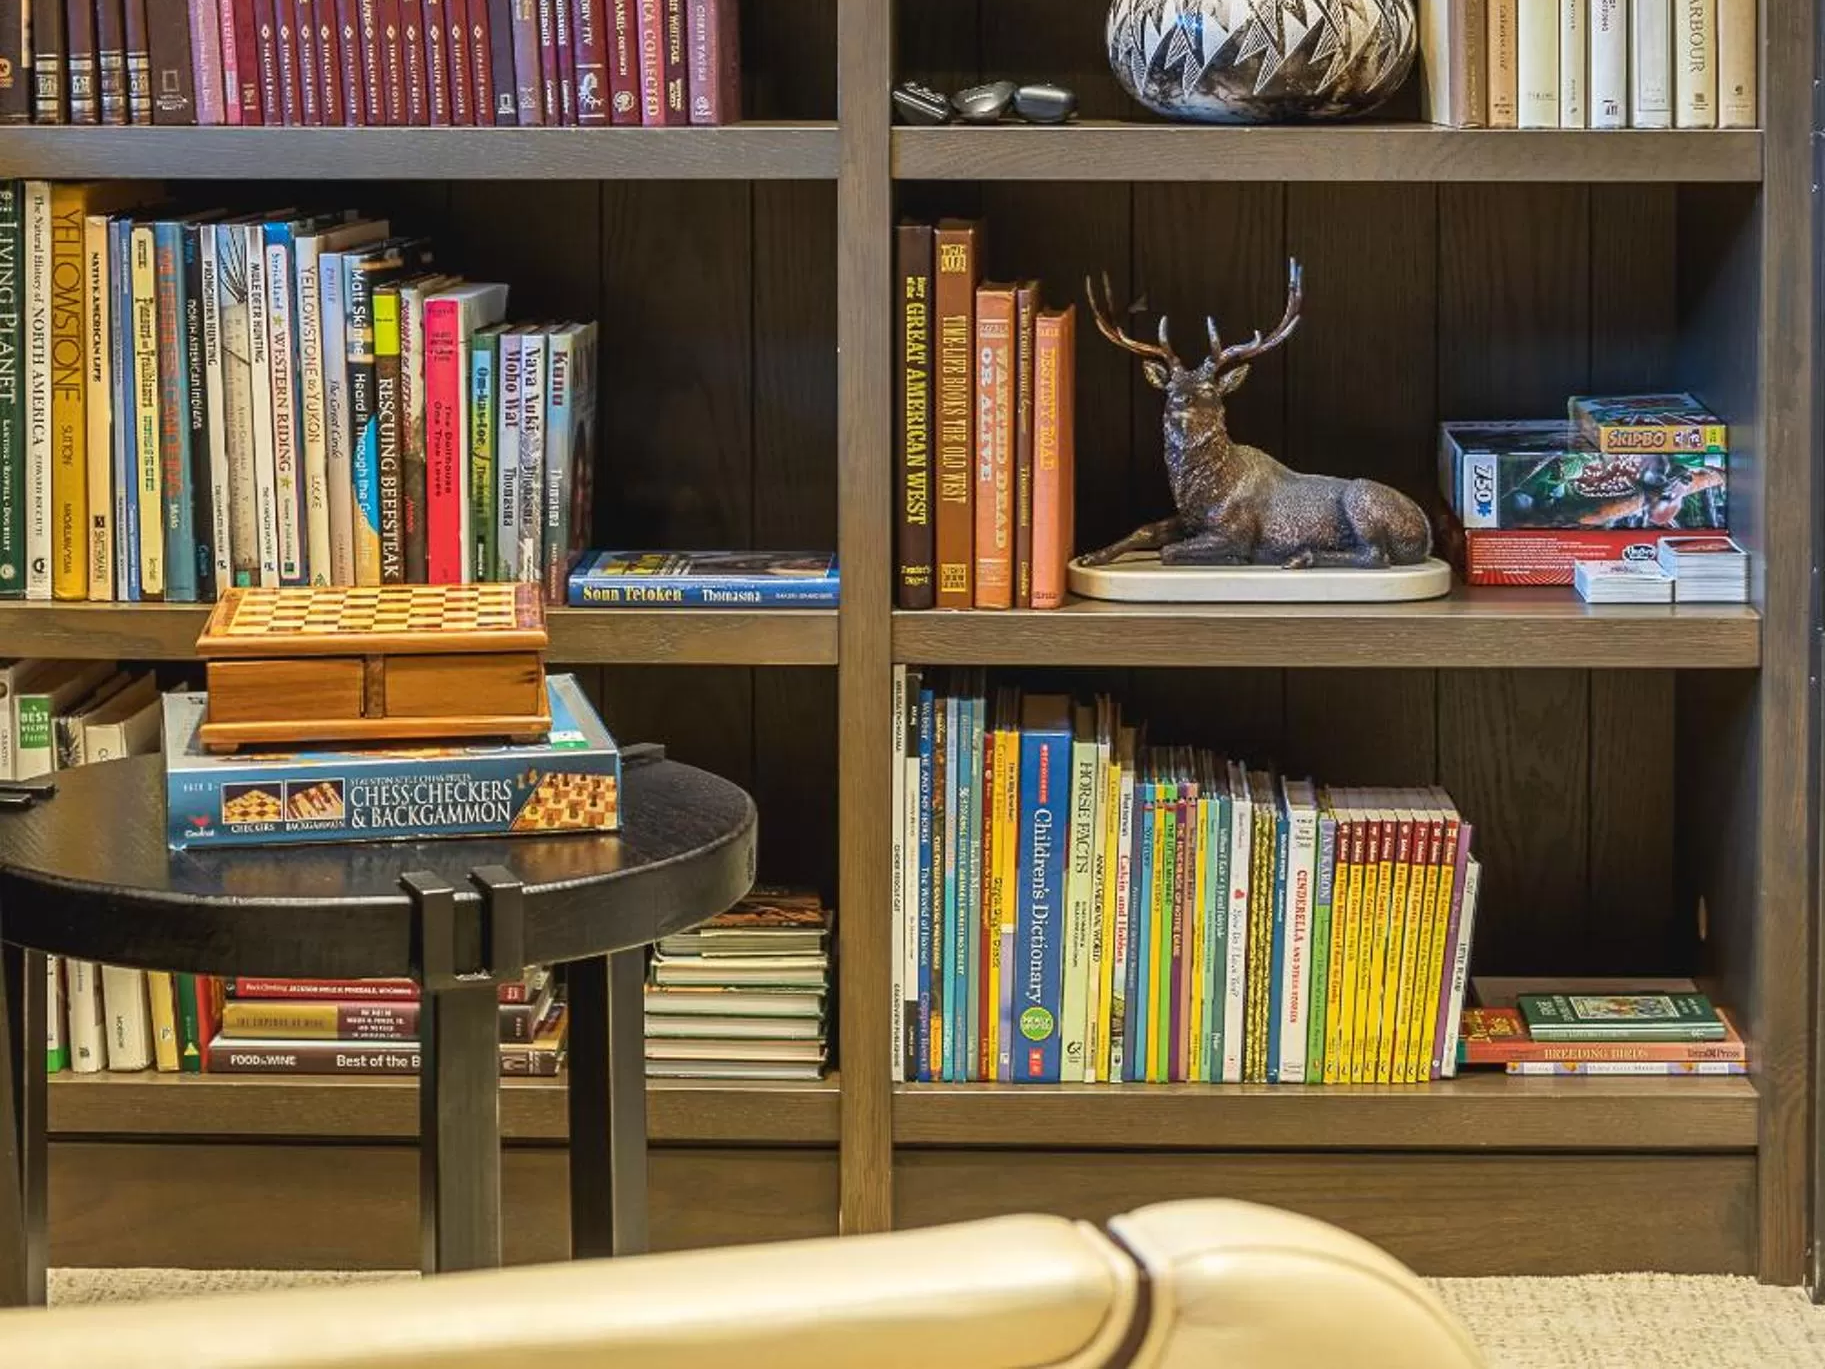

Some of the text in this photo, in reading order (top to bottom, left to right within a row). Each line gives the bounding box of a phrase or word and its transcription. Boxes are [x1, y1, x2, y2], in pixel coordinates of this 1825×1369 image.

[643, 30, 659, 117] COLLECTED
[250, 262, 262, 286] MULE
[352, 269, 366, 302] Matt
[0, 221, 18, 403] LIVING PLANET
[31, 195, 47, 444] The Natural History of NORTH AMERICA
[52, 209, 81, 402] YELLOWSTONE
[91, 252, 103, 383] NATIVE AMERICAN LIFE
[203, 260, 219, 365] PRONGHORN HUNTING
[253, 320, 265, 363] HUNTING
[301, 266, 320, 443] YELLOWSTONE YUKON
[524, 346, 540, 387] Naya
[274, 331, 291, 471] WESTERN RIDING
[353, 373, 368, 411] Heard
[552, 350, 568, 406] Kunu
[329, 379, 344, 459] The Great Circle
[906, 302, 927, 525] GREAT AMERICAN WEST
[942, 315, 967, 503] TIME-LIFE BOOKS THE OLD WEST
[980, 346, 993, 482] OR ALIVE
[1039, 347, 1056, 471] DESTINY ROAD
[61, 425, 74, 466] SUTTON
[355, 423, 370, 475] Through
[434, 430, 442, 497] True Loves
[444, 432, 454, 494] Dollhouse
[994, 346, 1009, 549] WANTED DEAD
[356, 478, 370, 498] the
[379, 377, 399, 576] RESCUING BEEFSTEAK
[503, 467, 518, 527] Thomasma
[549, 468, 564, 527] Thomasma
[1473, 465, 1493, 506] 750
[169, 502, 181, 529] Malo
[624, 586, 683, 602] Tetoken
[701, 588, 762, 603] Thomasma
[21, 711, 48, 722] BEST
[919, 702, 931, 740] Webber
[920, 771, 930, 792] AND
[230, 823, 275, 834] CHECKERS
[351, 802, 512, 828] & BACKGAMMON
[920, 812, 930, 844] HORSE
[1076, 761, 1093, 874] HORSE FACTS
[920, 866, 931, 881] The
[1319, 831, 1333, 899] JAN KARON
[919, 882, 931, 917] World
[1028, 808, 1053, 1003] Children's Dictionary
[1115, 854, 1131, 964] Calvin and Hobbes
[1293, 870, 1308, 942] CINDERELLA
[918, 930, 931, 966] Horses
[336, 1054, 366, 1067] Best
[369, 1054, 383, 1067] of
[386, 1054, 409, 1067] the
